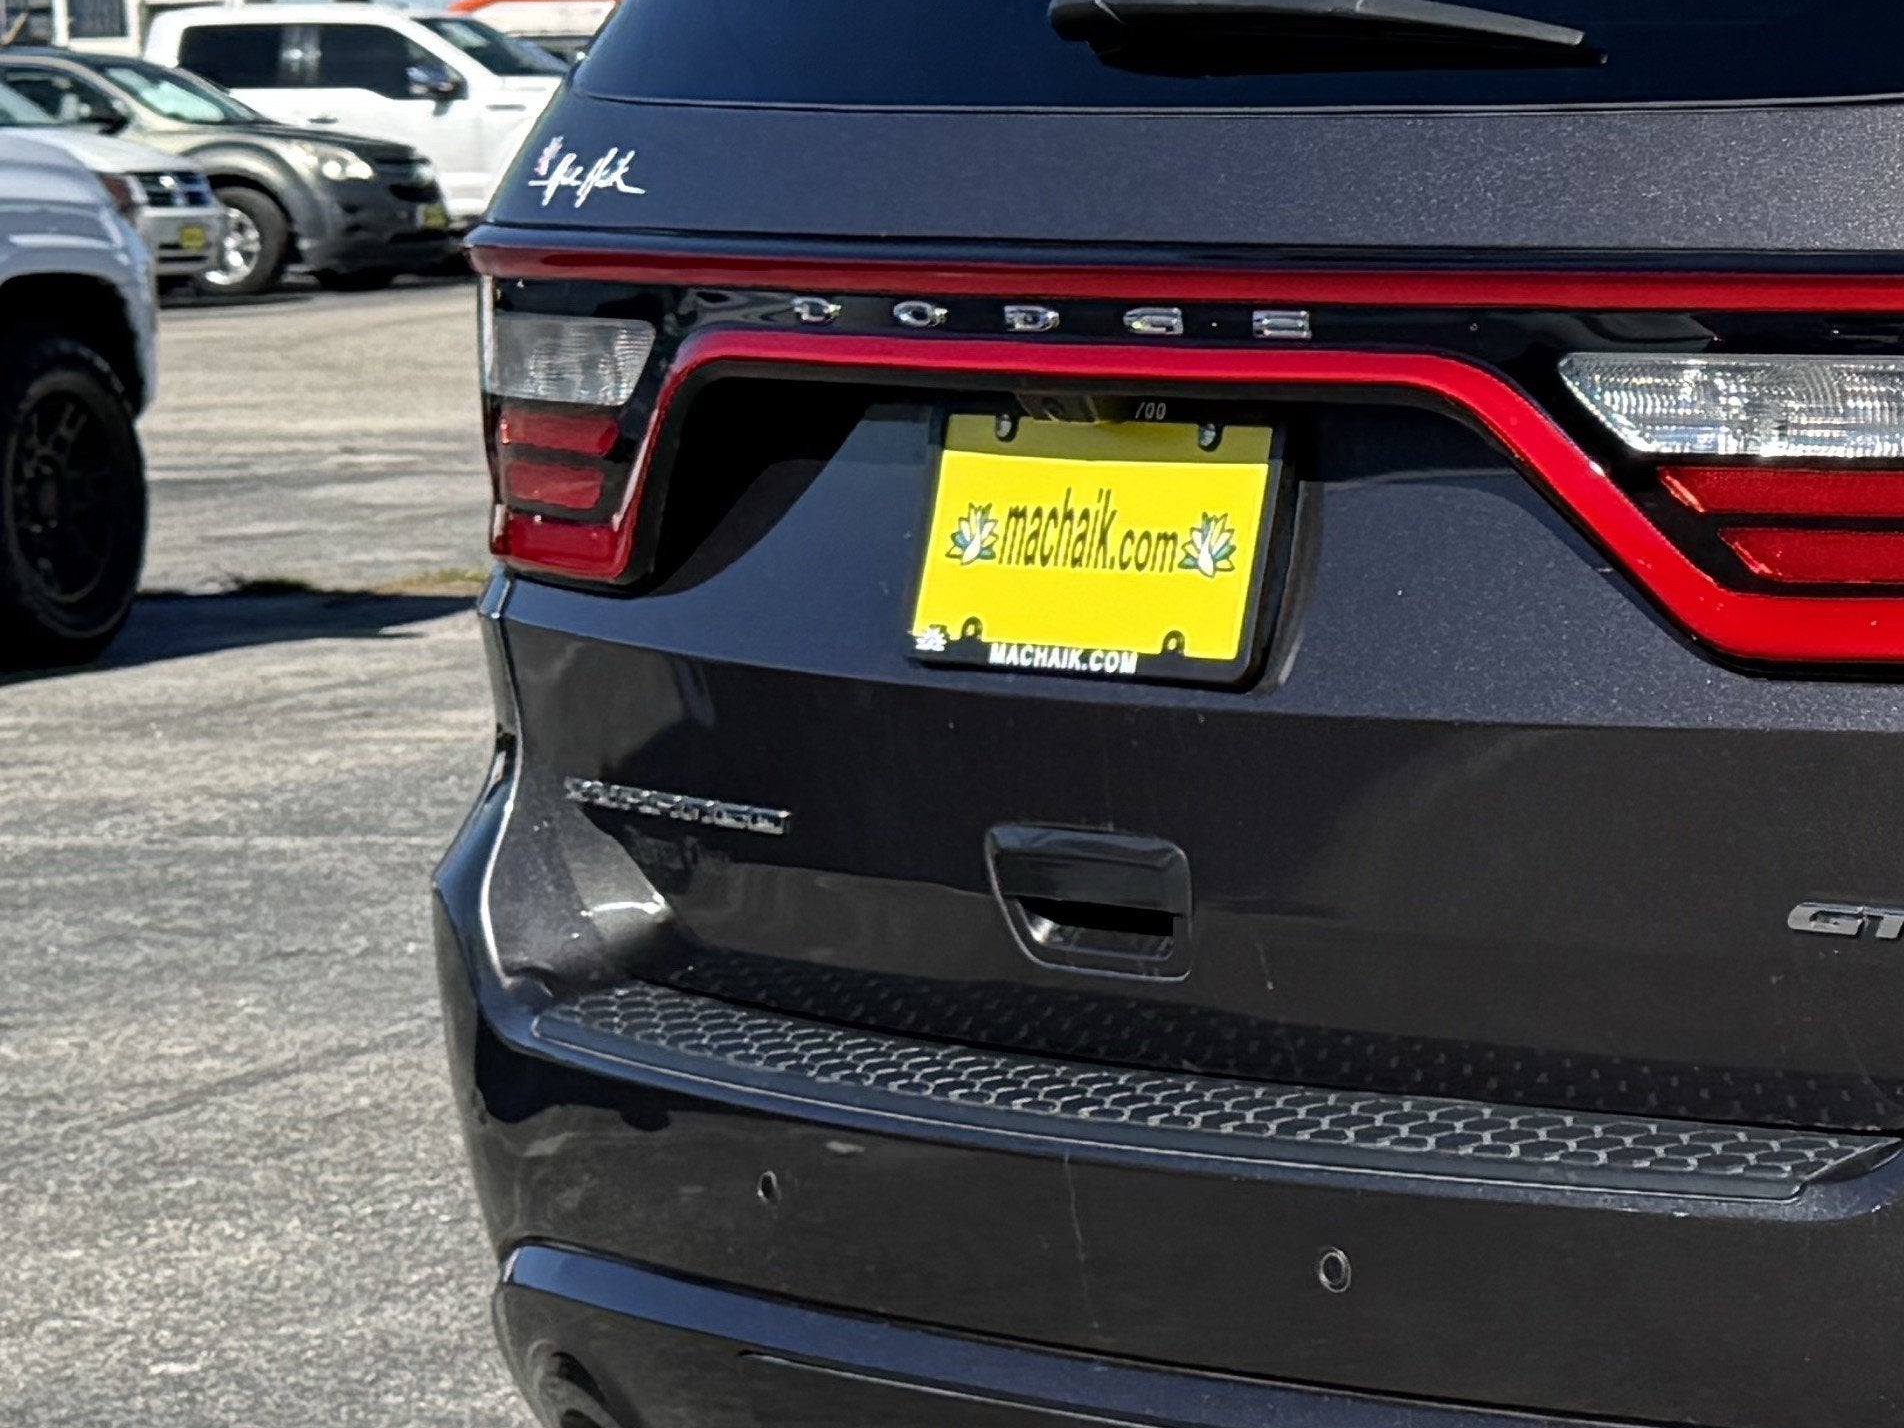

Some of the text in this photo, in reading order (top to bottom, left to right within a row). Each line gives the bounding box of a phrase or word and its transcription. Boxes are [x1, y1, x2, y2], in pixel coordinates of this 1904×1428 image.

[792, 296, 1312, 340] DODGE
[997, 486, 1179, 573] machaik.com
[988, 641, 1138, 674] MACHAIK.COM
